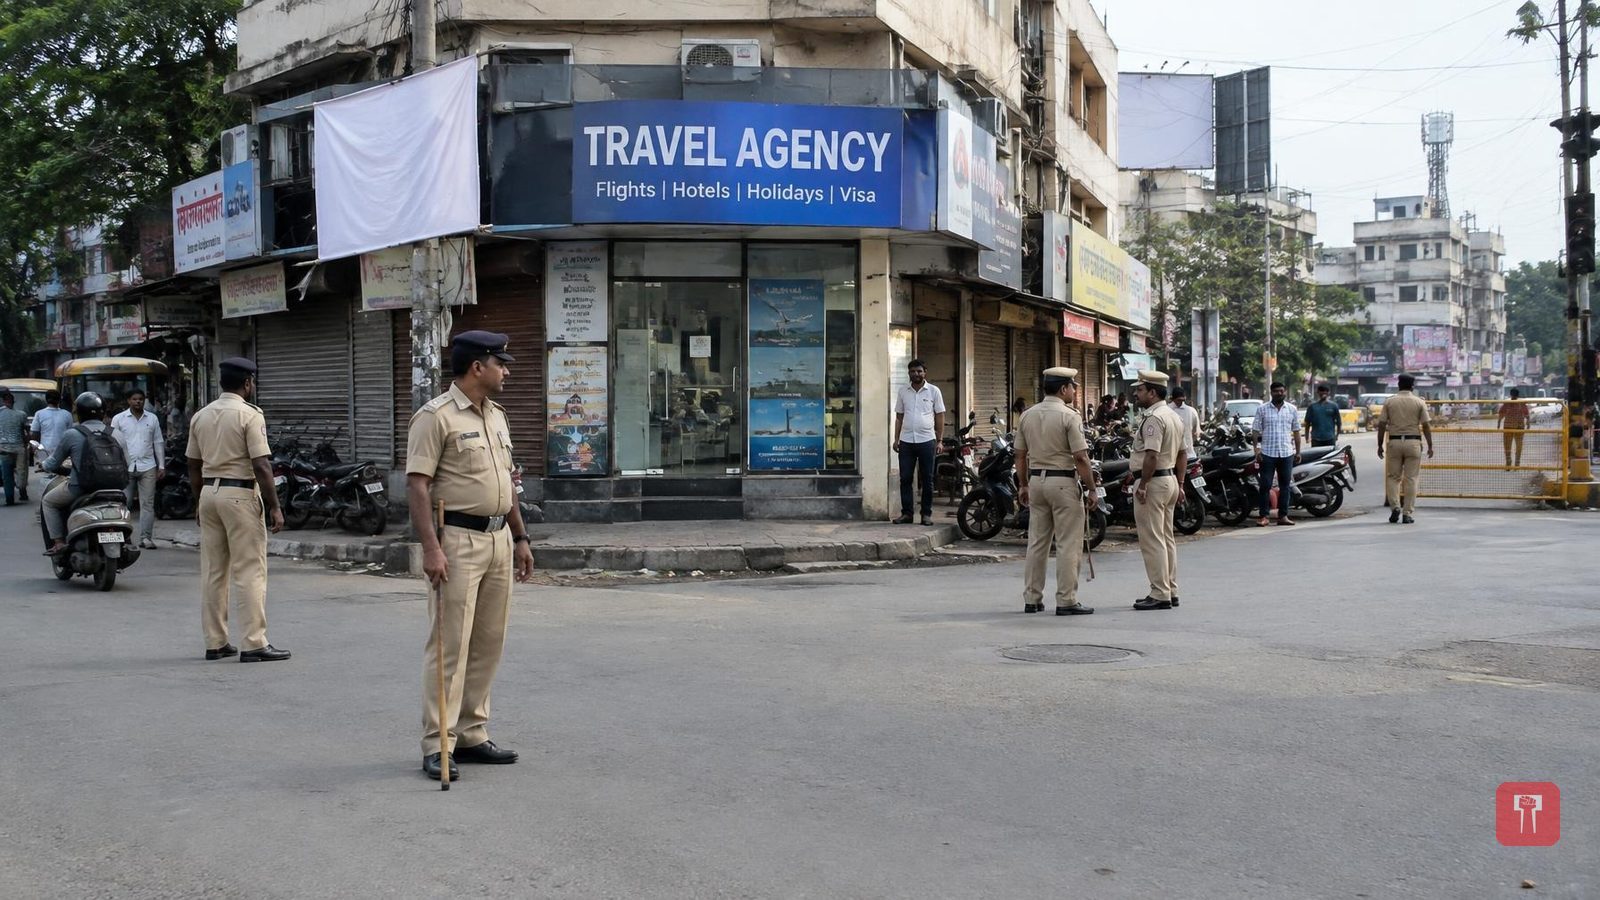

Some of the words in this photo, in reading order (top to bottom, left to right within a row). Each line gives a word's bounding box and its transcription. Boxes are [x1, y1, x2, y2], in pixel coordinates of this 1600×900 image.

[583, 125, 727, 167] TRAVEL
[735, 127, 892, 172] AGENCY
[596, 181, 656, 202] Flights
[673, 182, 730, 199] Hotels
[747, 183, 824, 204] Holidays
[840, 186, 876, 203] Visa
